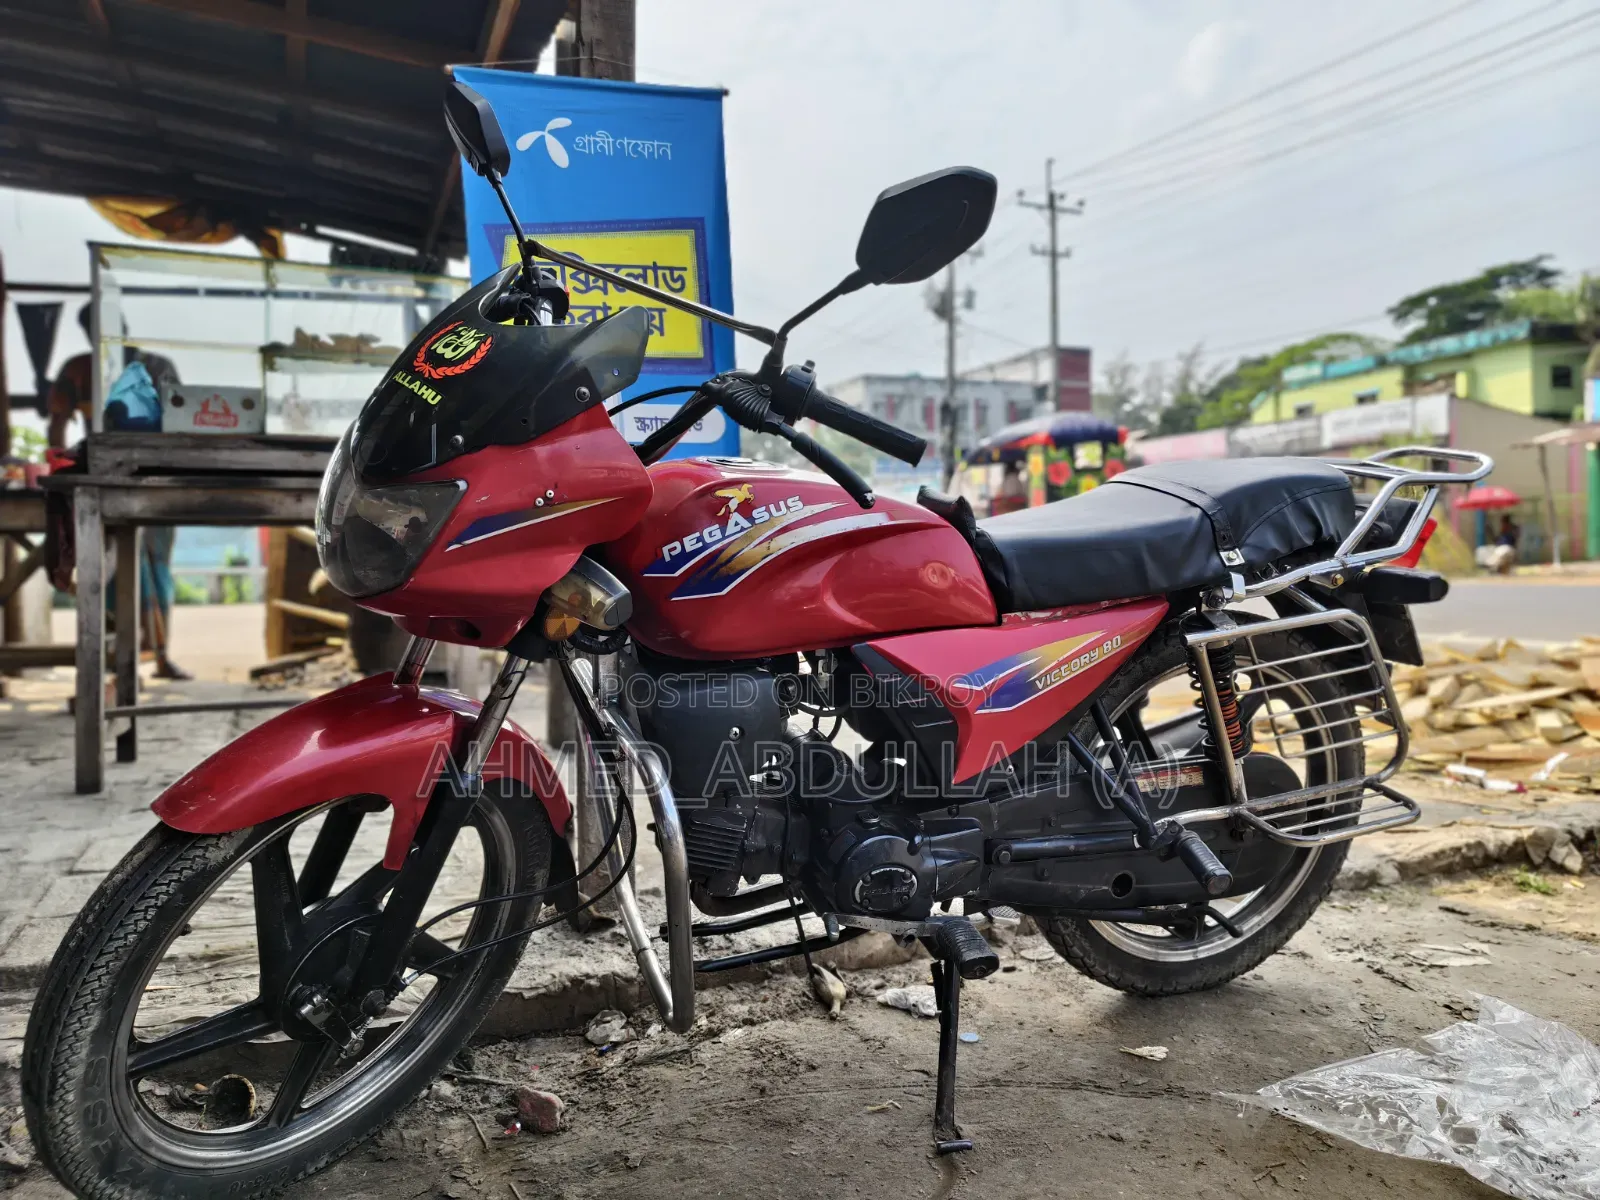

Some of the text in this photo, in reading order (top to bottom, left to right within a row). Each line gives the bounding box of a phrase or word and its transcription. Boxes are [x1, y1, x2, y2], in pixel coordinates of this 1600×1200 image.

[573, 130, 672, 160] গ্রামীণফোন
[393, 371, 443, 405] ALLAHU
[661, 495, 805, 562] PEGASUS
[1035, 635, 1122, 690] VICTORY 80
